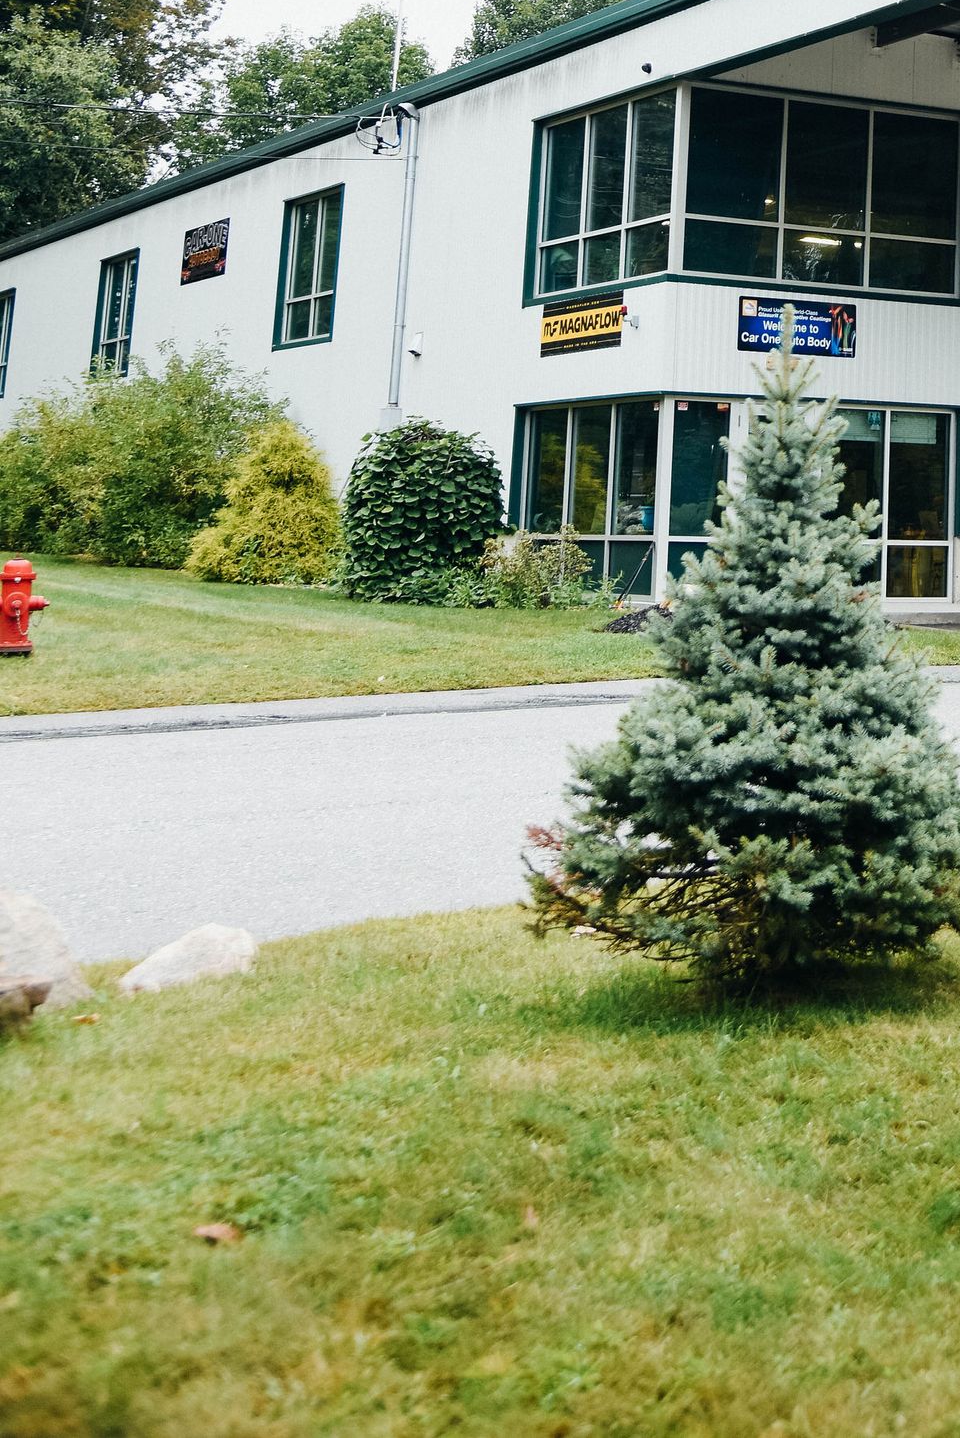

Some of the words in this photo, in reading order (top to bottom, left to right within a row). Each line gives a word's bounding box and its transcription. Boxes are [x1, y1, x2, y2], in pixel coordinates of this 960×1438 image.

[184, 223, 228, 260] CAR-ONE
[559, 310, 621, 335] MAGNAFLOW
[763, 320, 807, 333] Welcme
[809, 323, 819, 334] to
[741, 332, 760, 343] Car
[761, 333, 781, 344] One
[807, 336, 832, 349] Body
